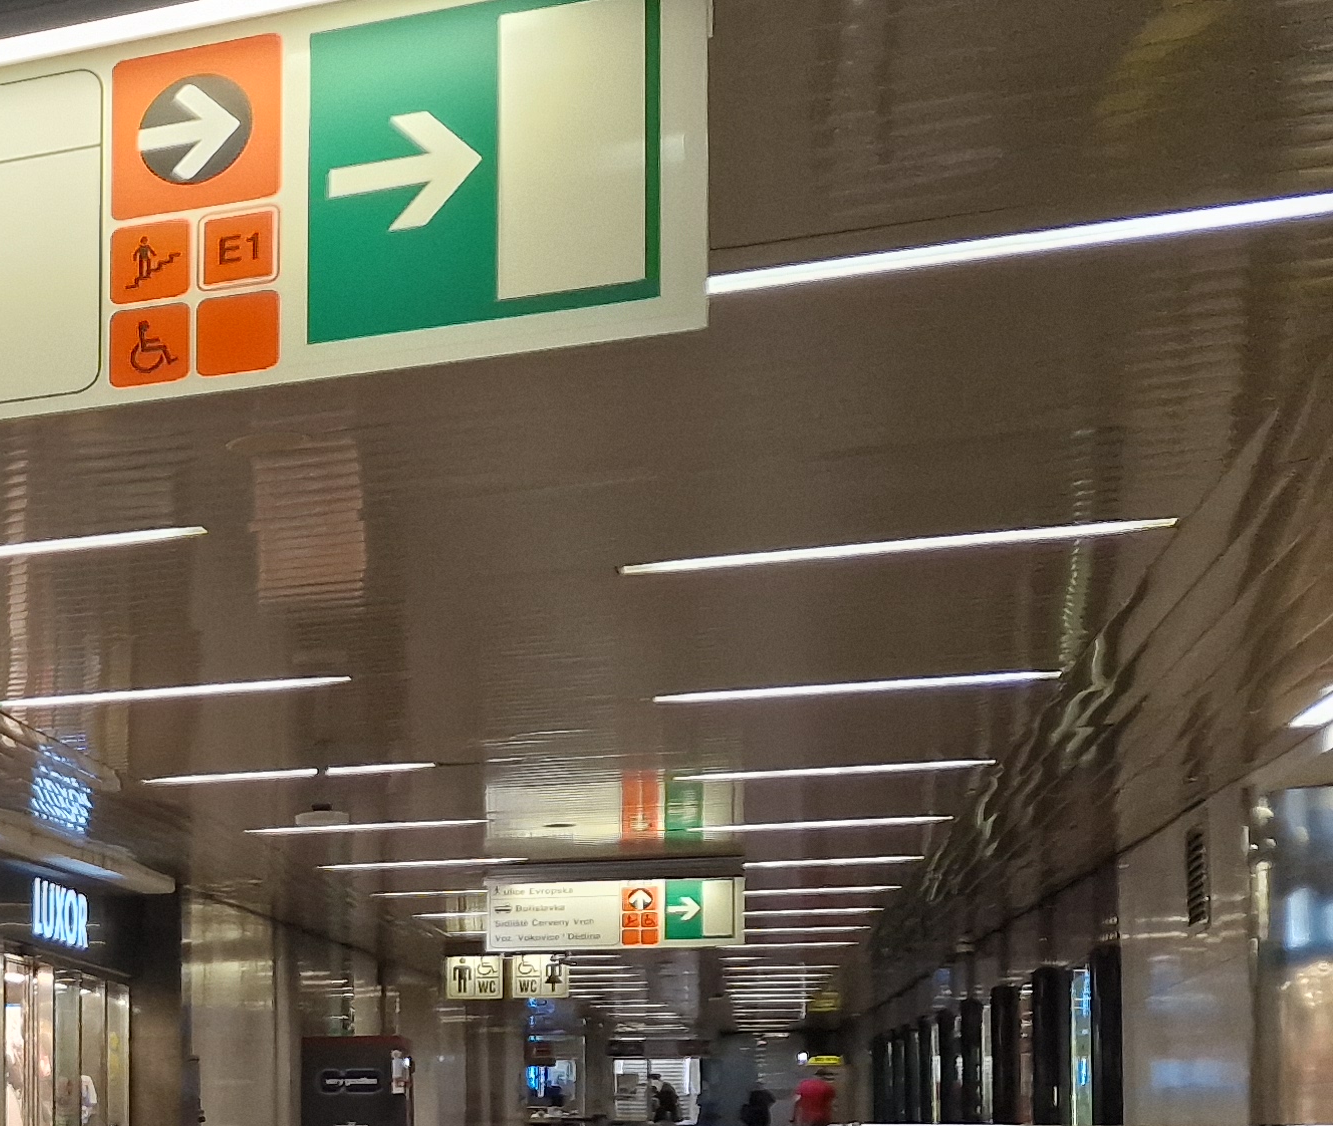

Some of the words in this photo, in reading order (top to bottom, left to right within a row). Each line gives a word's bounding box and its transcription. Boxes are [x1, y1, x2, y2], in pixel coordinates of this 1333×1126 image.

[218, 231, 260, 265] E1
[32, 876, 90, 949] LUXOR
[478, 980, 496, 993] WC
[519, 979, 538, 993] WC
